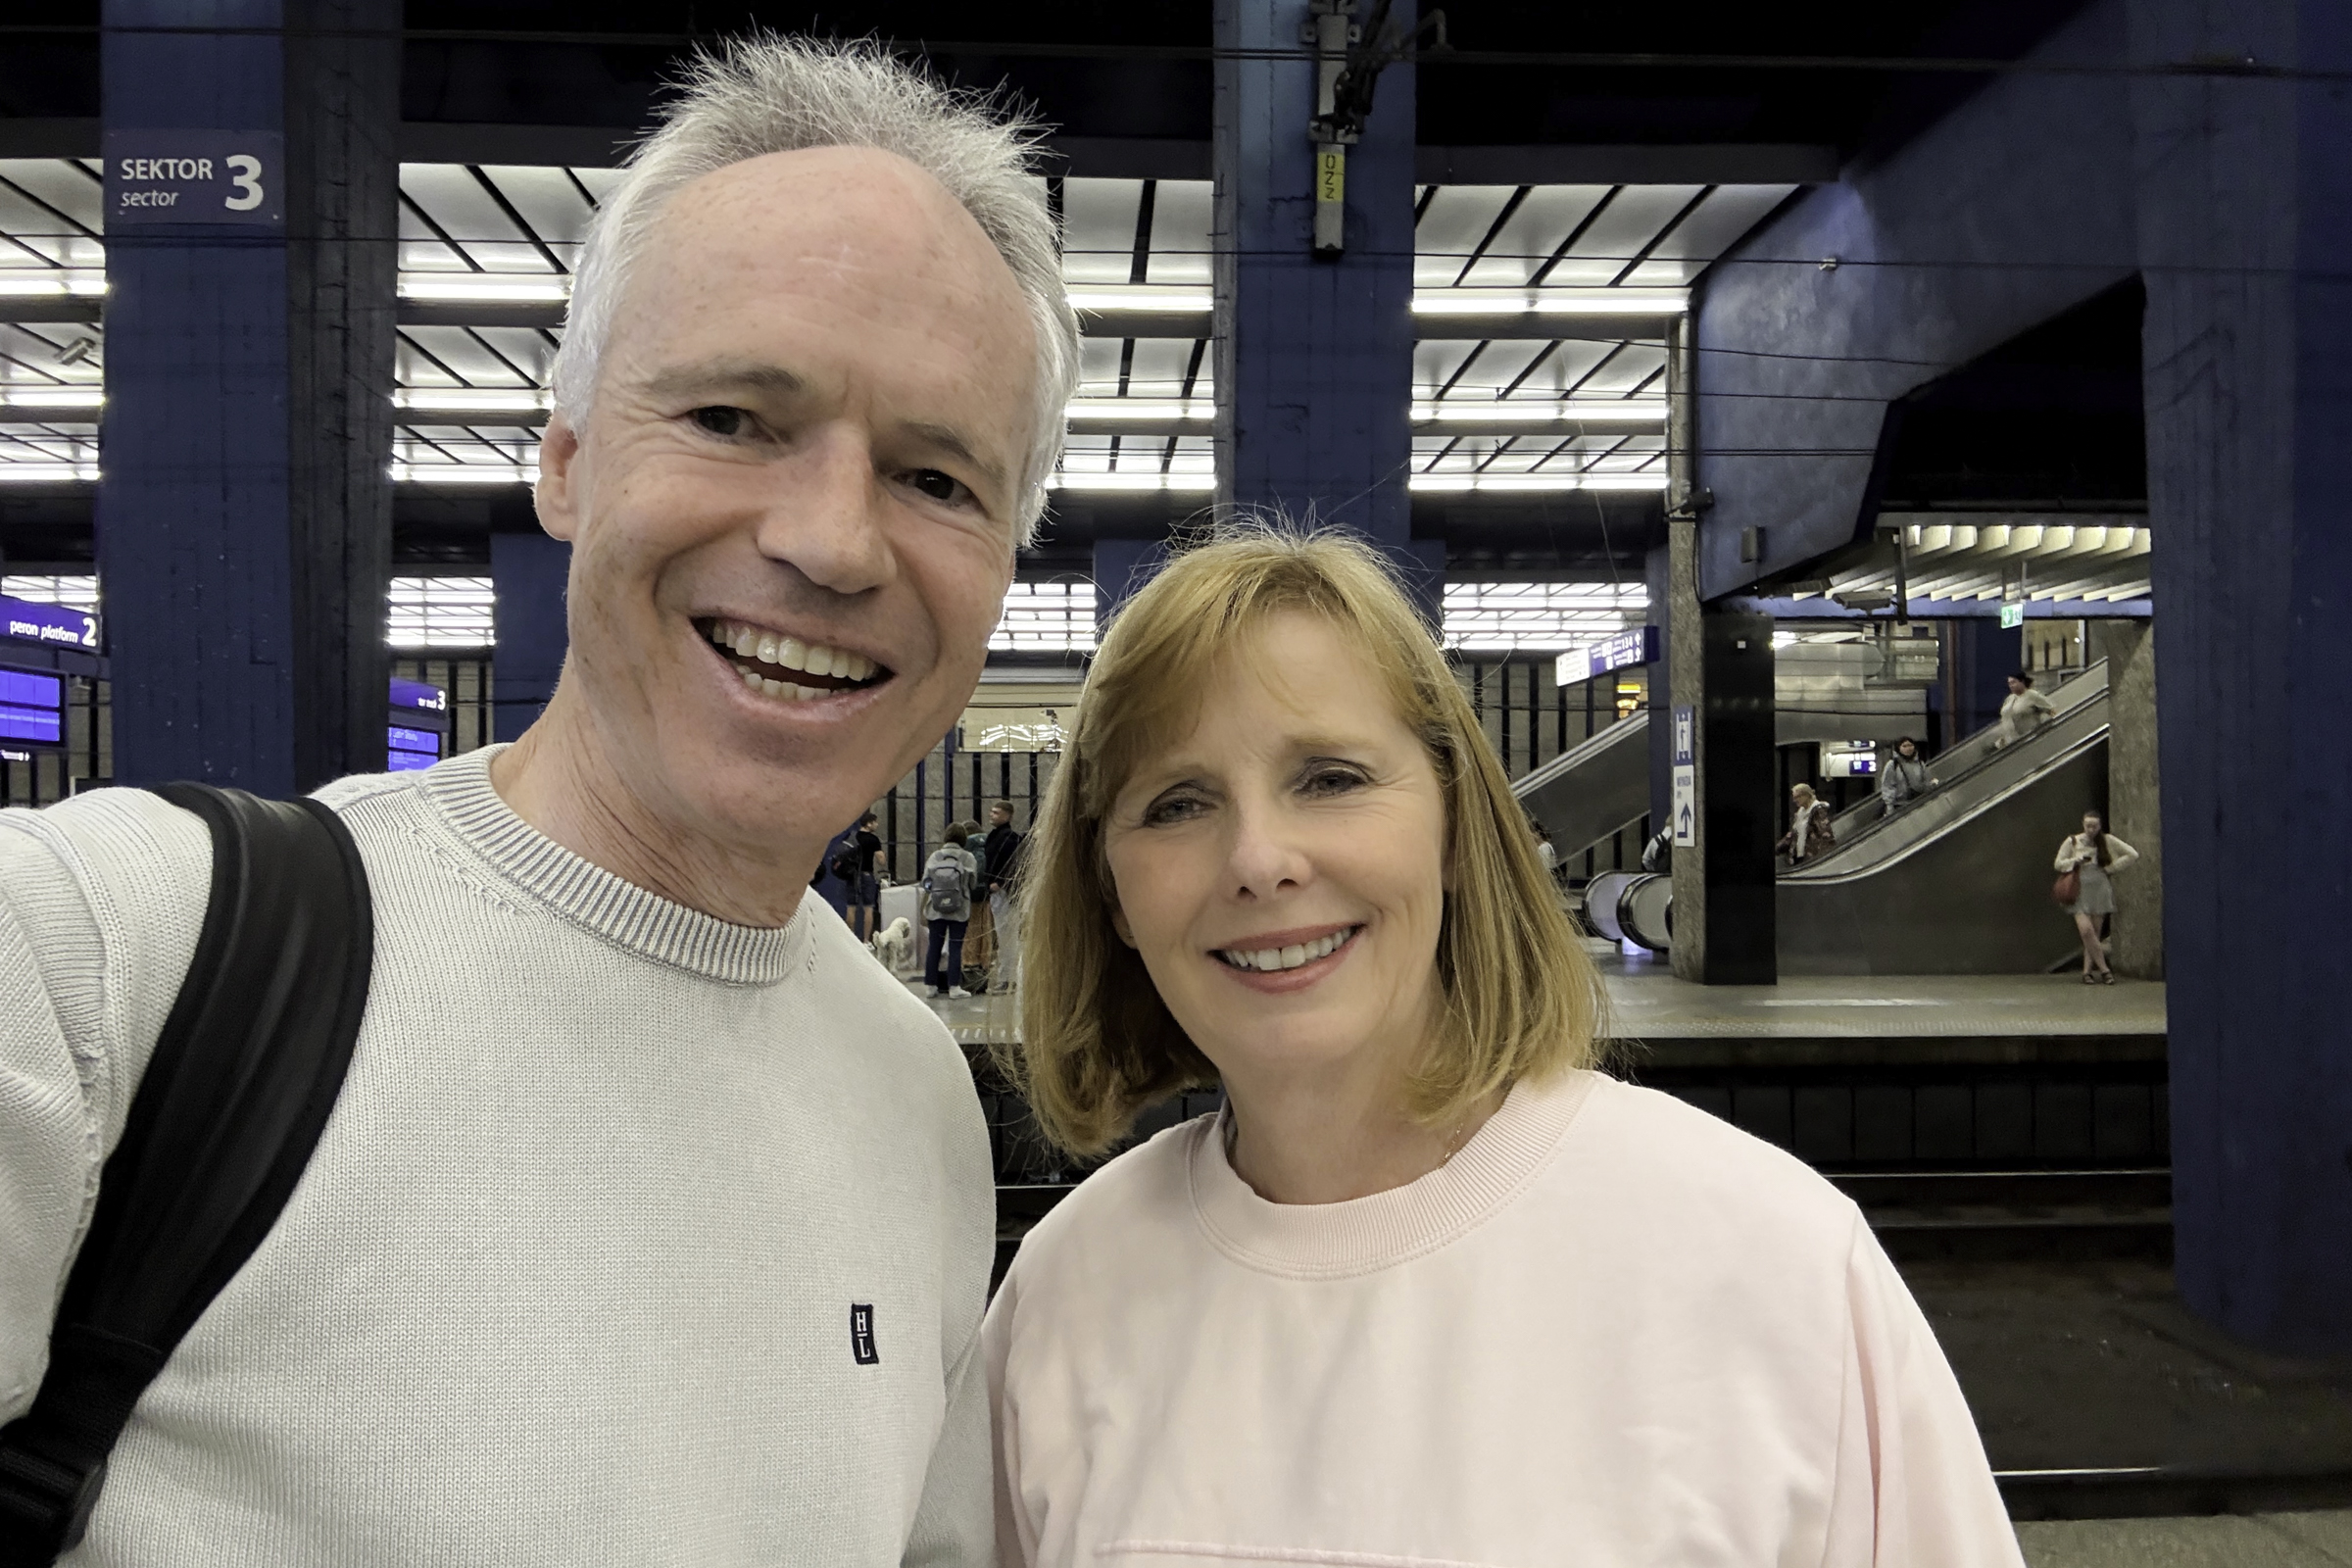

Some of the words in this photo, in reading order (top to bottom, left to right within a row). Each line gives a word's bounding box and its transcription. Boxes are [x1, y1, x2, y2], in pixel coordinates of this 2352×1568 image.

[121, 159, 213, 180] SEKTOR
[224, 154, 264, 212] 3
[121, 189, 179, 207] sector
[10, 620, 39, 636] peron
[41, 624, 79, 644] platform
[81, 616, 97, 647] 2
[437, 690, 446, 710] 3
